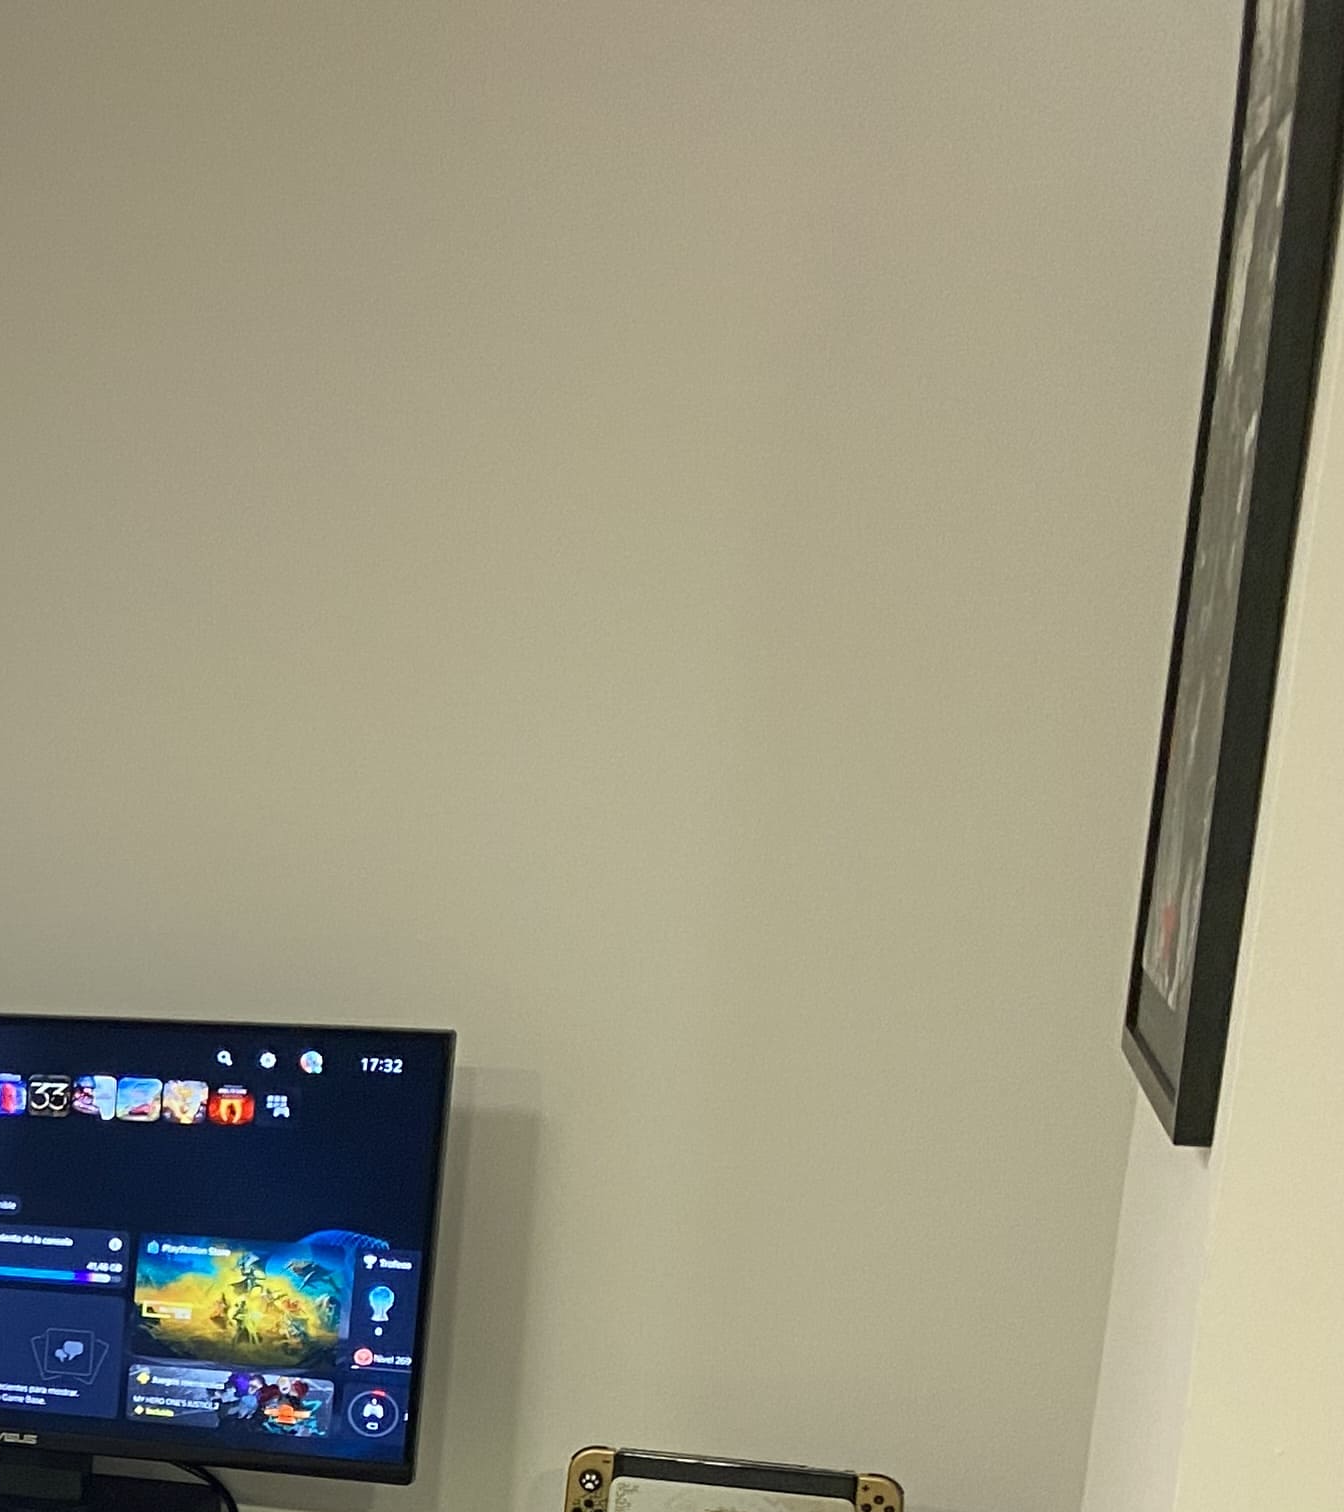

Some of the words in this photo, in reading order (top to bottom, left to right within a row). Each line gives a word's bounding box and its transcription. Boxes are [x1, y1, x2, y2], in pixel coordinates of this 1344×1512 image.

[360, 1057, 403, 1074] 17:32
[22, 1235, 33, 1243] de
[161, 1243, 207, 1255] PlayStation
[379, 1258, 412, 1270] Trofeos
[151, 1375, 179, 1387] Juegos
[28, 1385, 47, 1394] para
[1, 1393, 24, 1403] Game
